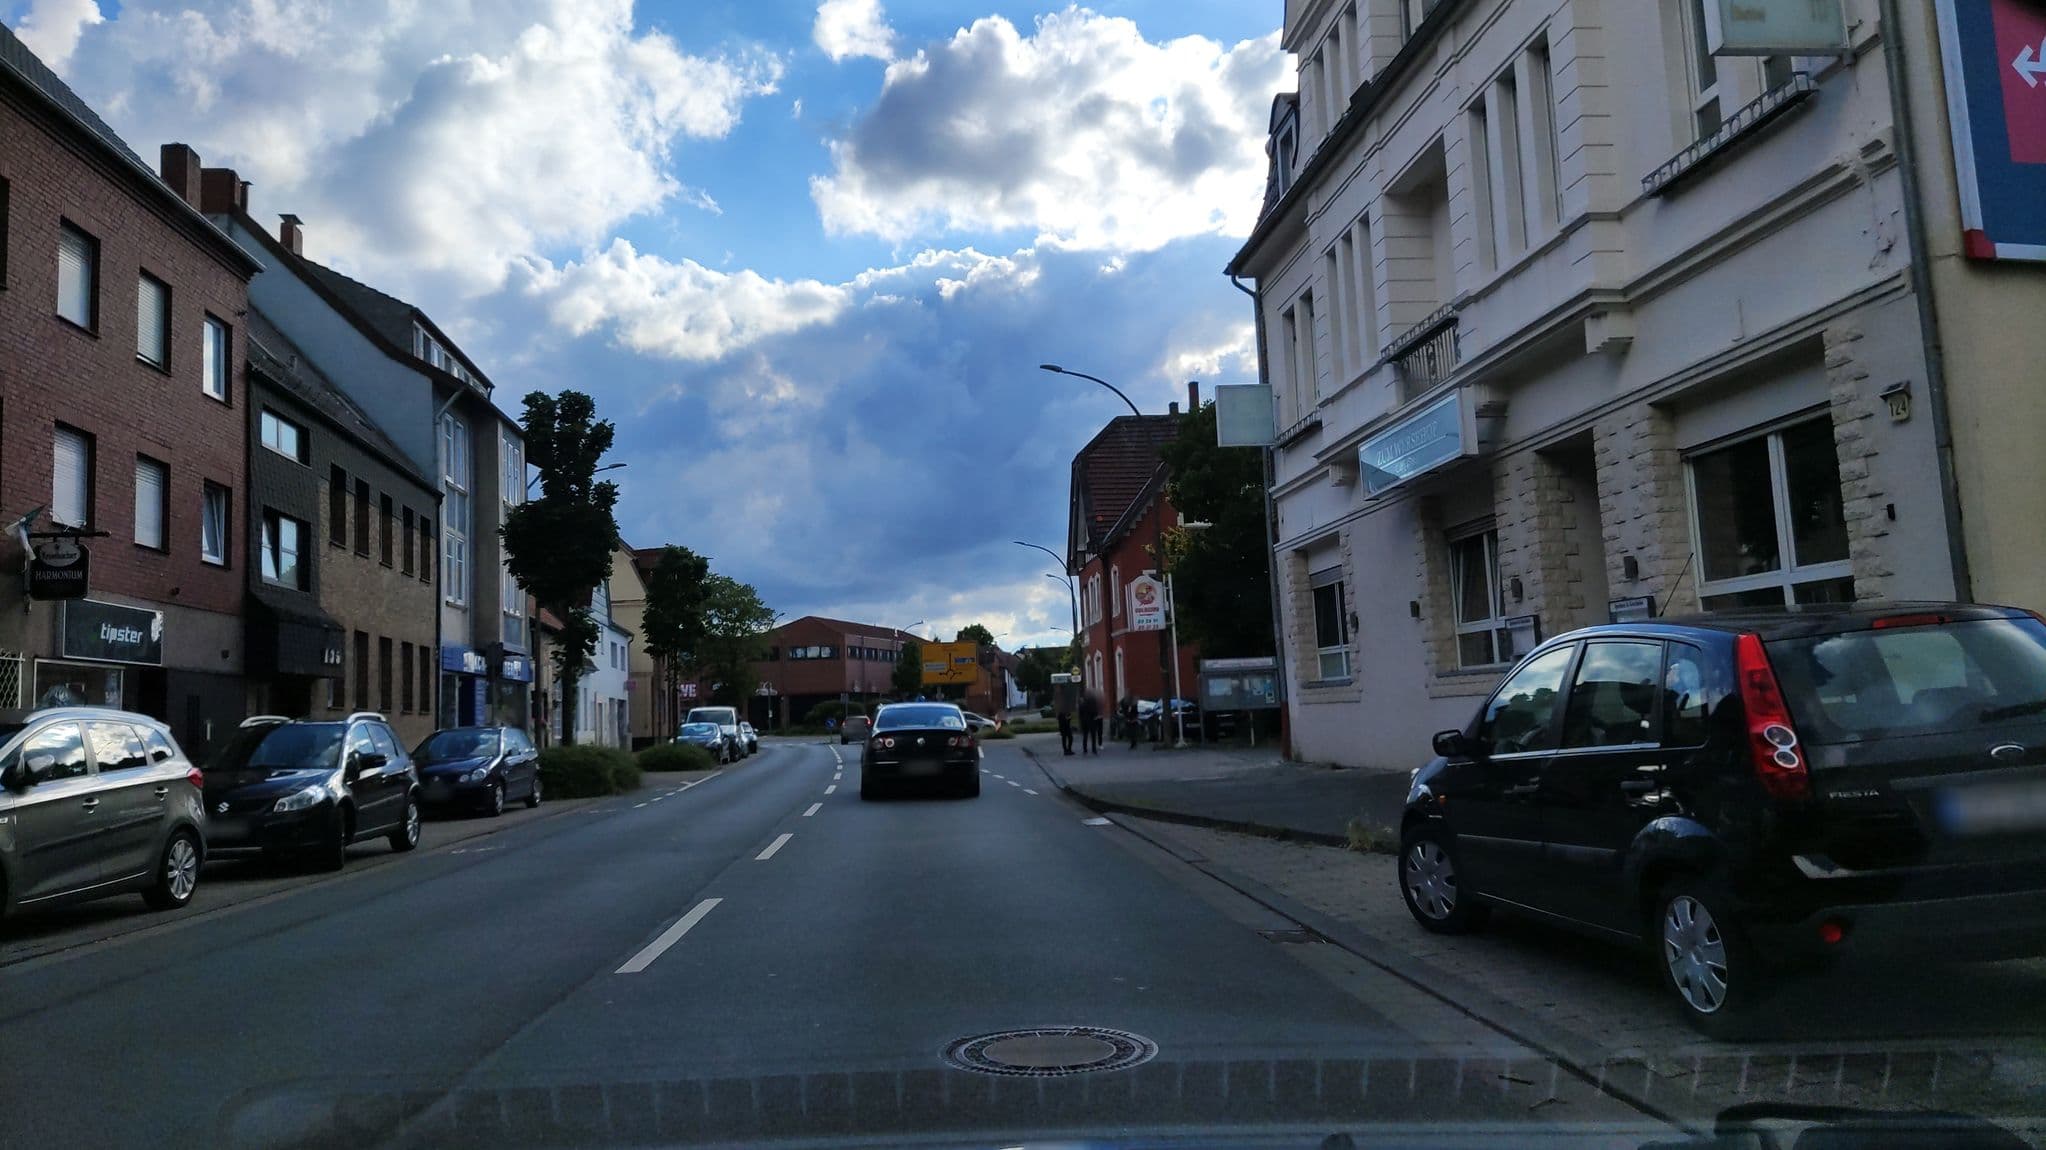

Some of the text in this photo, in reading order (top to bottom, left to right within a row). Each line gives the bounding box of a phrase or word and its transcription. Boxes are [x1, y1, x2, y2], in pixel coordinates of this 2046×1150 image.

[1889, 400, 1907, 417] 124
[34, 569, 83, 582] HARMONIUM
[100, 622, 143, 645] tipster
[1829, 790, 1880, 799] FIESTA
